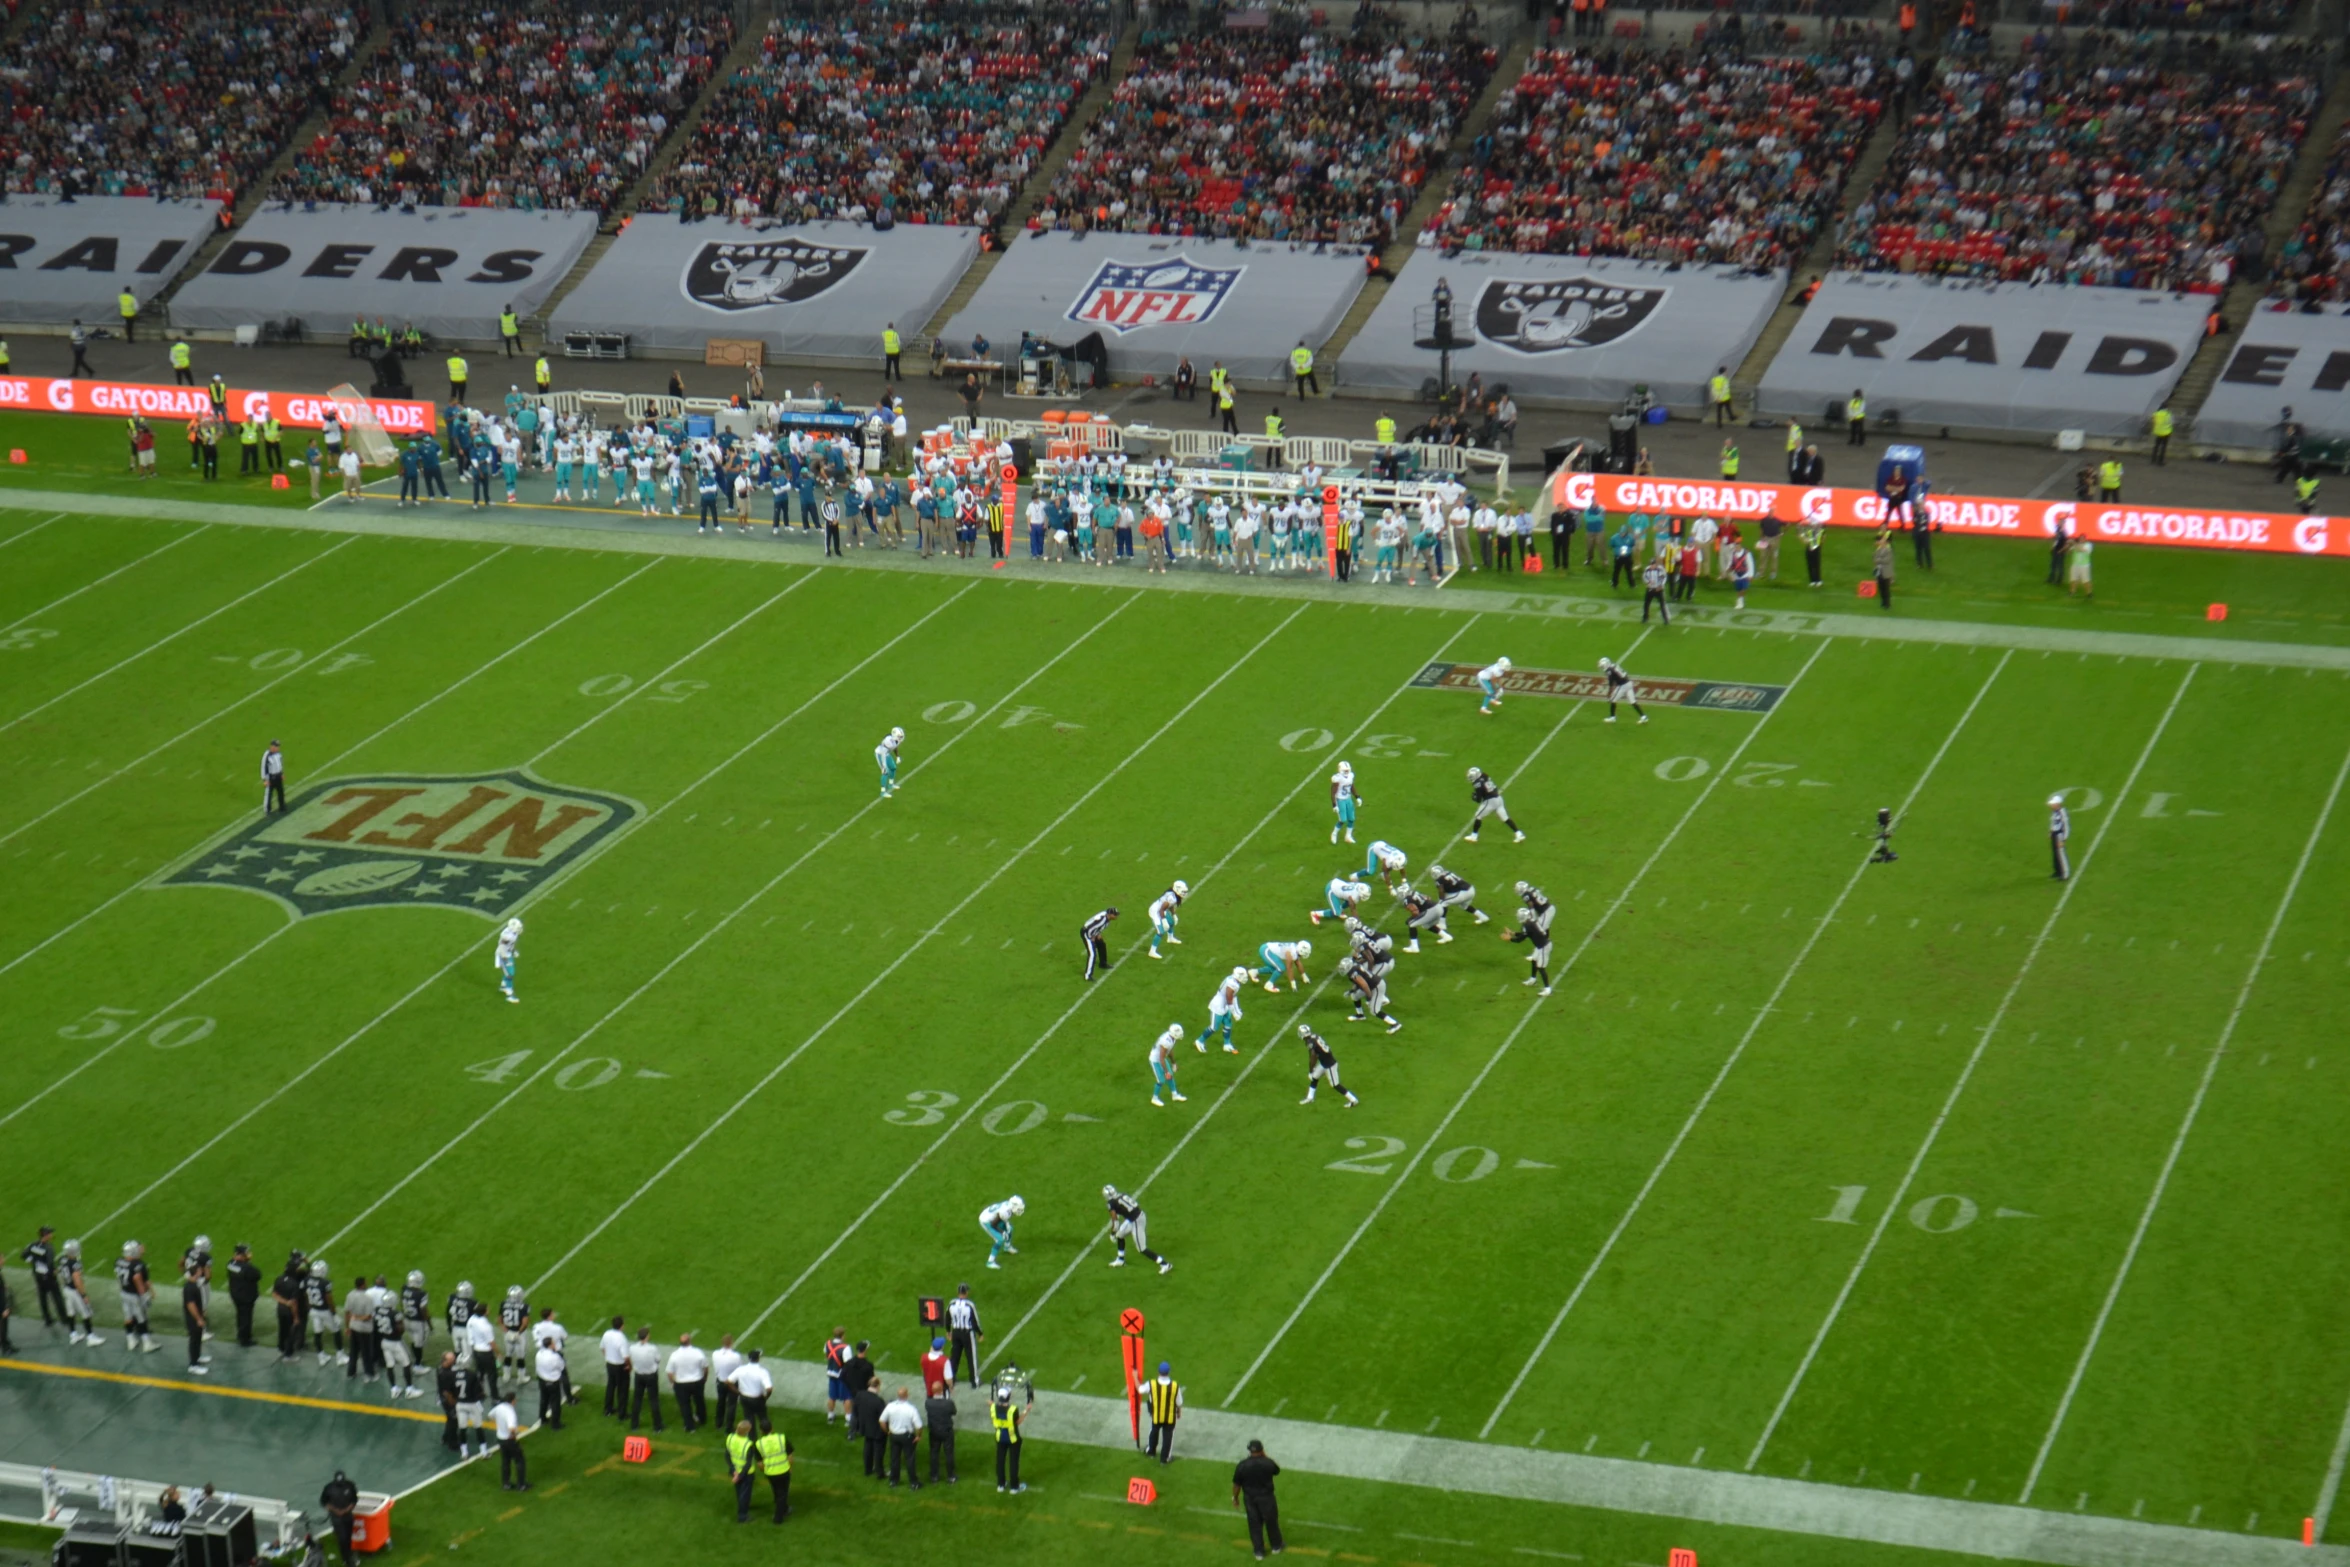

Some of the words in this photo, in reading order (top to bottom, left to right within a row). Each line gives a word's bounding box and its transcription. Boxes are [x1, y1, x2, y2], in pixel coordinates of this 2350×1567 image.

[717, 245, 850, 261] RAIDERS
[1082, 289, 1197, 324] NFL
[1503, 283, 1647, 302] RAIDERS
[91, 387, 215, 413] GATORAD
[1565, 475, 1595, 507] G
[1616, 482, 1778, 513] GATORADE
[2098, 511, 2270, 543] GATORADE
[2294, 517, 2328, 553] G
[578, 672, 710, 703] 50
[921, 700, 1052, 730] 40
[1279, 727, 1416, 758] 30
[1654, 755, 1799, 788] 20
[303, 785, 601, 860] NFL
[57, 1006, 217, 1049] 50
[463, 1048, 623, 1091] 40
[883, 1090, 1048, 1135] 30
[1324, 1135, 1499, 1183] 20
[1811, 1185, 1978, 1234] 10
[502, 1308, 520, 1327] 21
[626, 1441, 644, 1460] 30
[1130, 1483, 1148, 1501] 20
